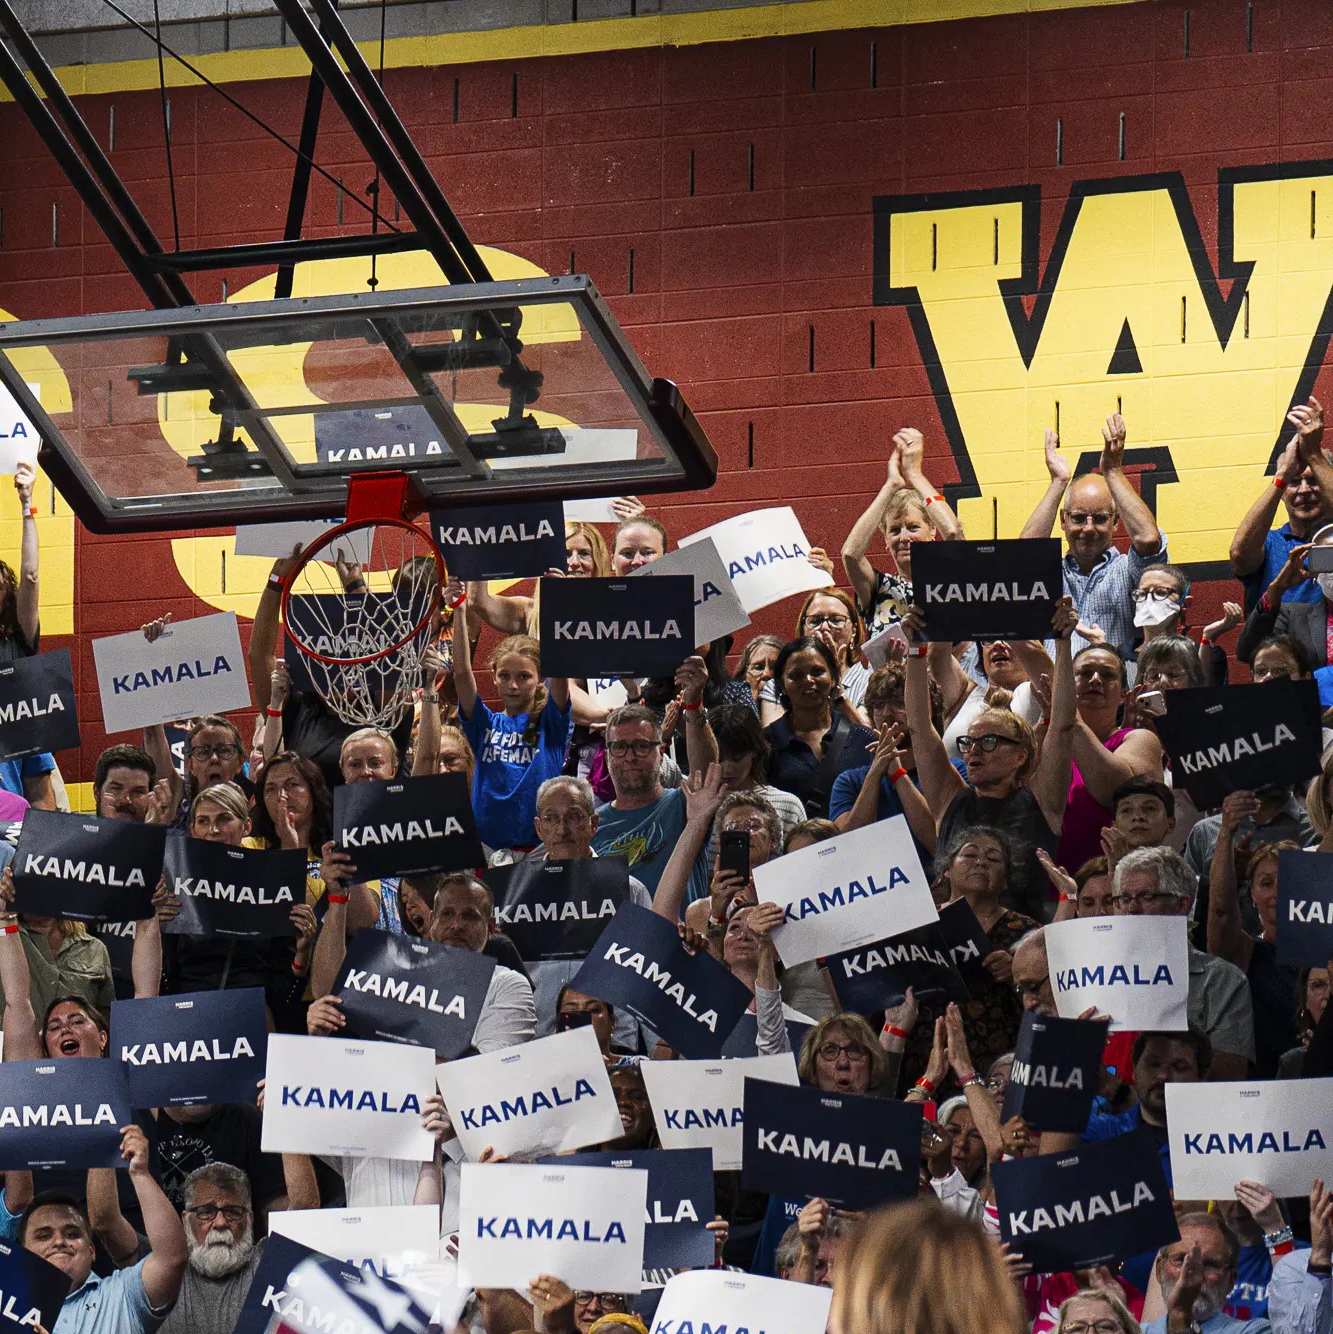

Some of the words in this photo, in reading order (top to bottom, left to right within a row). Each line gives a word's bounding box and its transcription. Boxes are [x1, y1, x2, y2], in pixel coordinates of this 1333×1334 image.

[439, 518, 555, 544] KAMALA
[728, 542, 806, 579] AMALA
[925, 581, 1050, 603] KAMALA
[554, 619, 682, 639] KAMALA
[113, 655, 231, 694] KAMALA
[492, 745, 540, 764] FEMA
[1180, 722, 1296, 773] KAMALA
[341, 816, 464, 848] KAMALA
[24, 854, 145, 887] KAMALA
[174, 877, 294, 904] KAMALA
[783, 865, 910, 923] KAMALA
[494, 897, 617, 924] KAMALA
[843, 945, 950, 977] KAMALA
[604, 941, 719, 1034] KAMALA
[1056, 965, 1173, 991] KAMALA
[344, 967, 466, 1020] KAMALA
[122, 1036, 254, 1065] KAMALA
[1010, 1060, 1083, 1089] AMALA
[283, 1085, 421, 1114] KAMALA
[460, 1077, 596, 1130] KAMALA
[664, 1107, 744, 1130] KAMA
[758, 1128, 902, 1172] KAMALA
[1184, 1128, 1326, 1154] KAMALA
[1010, 1181, 1156, 1236] KAMALA
[478, 1217, 626, 1244] KAMALA
